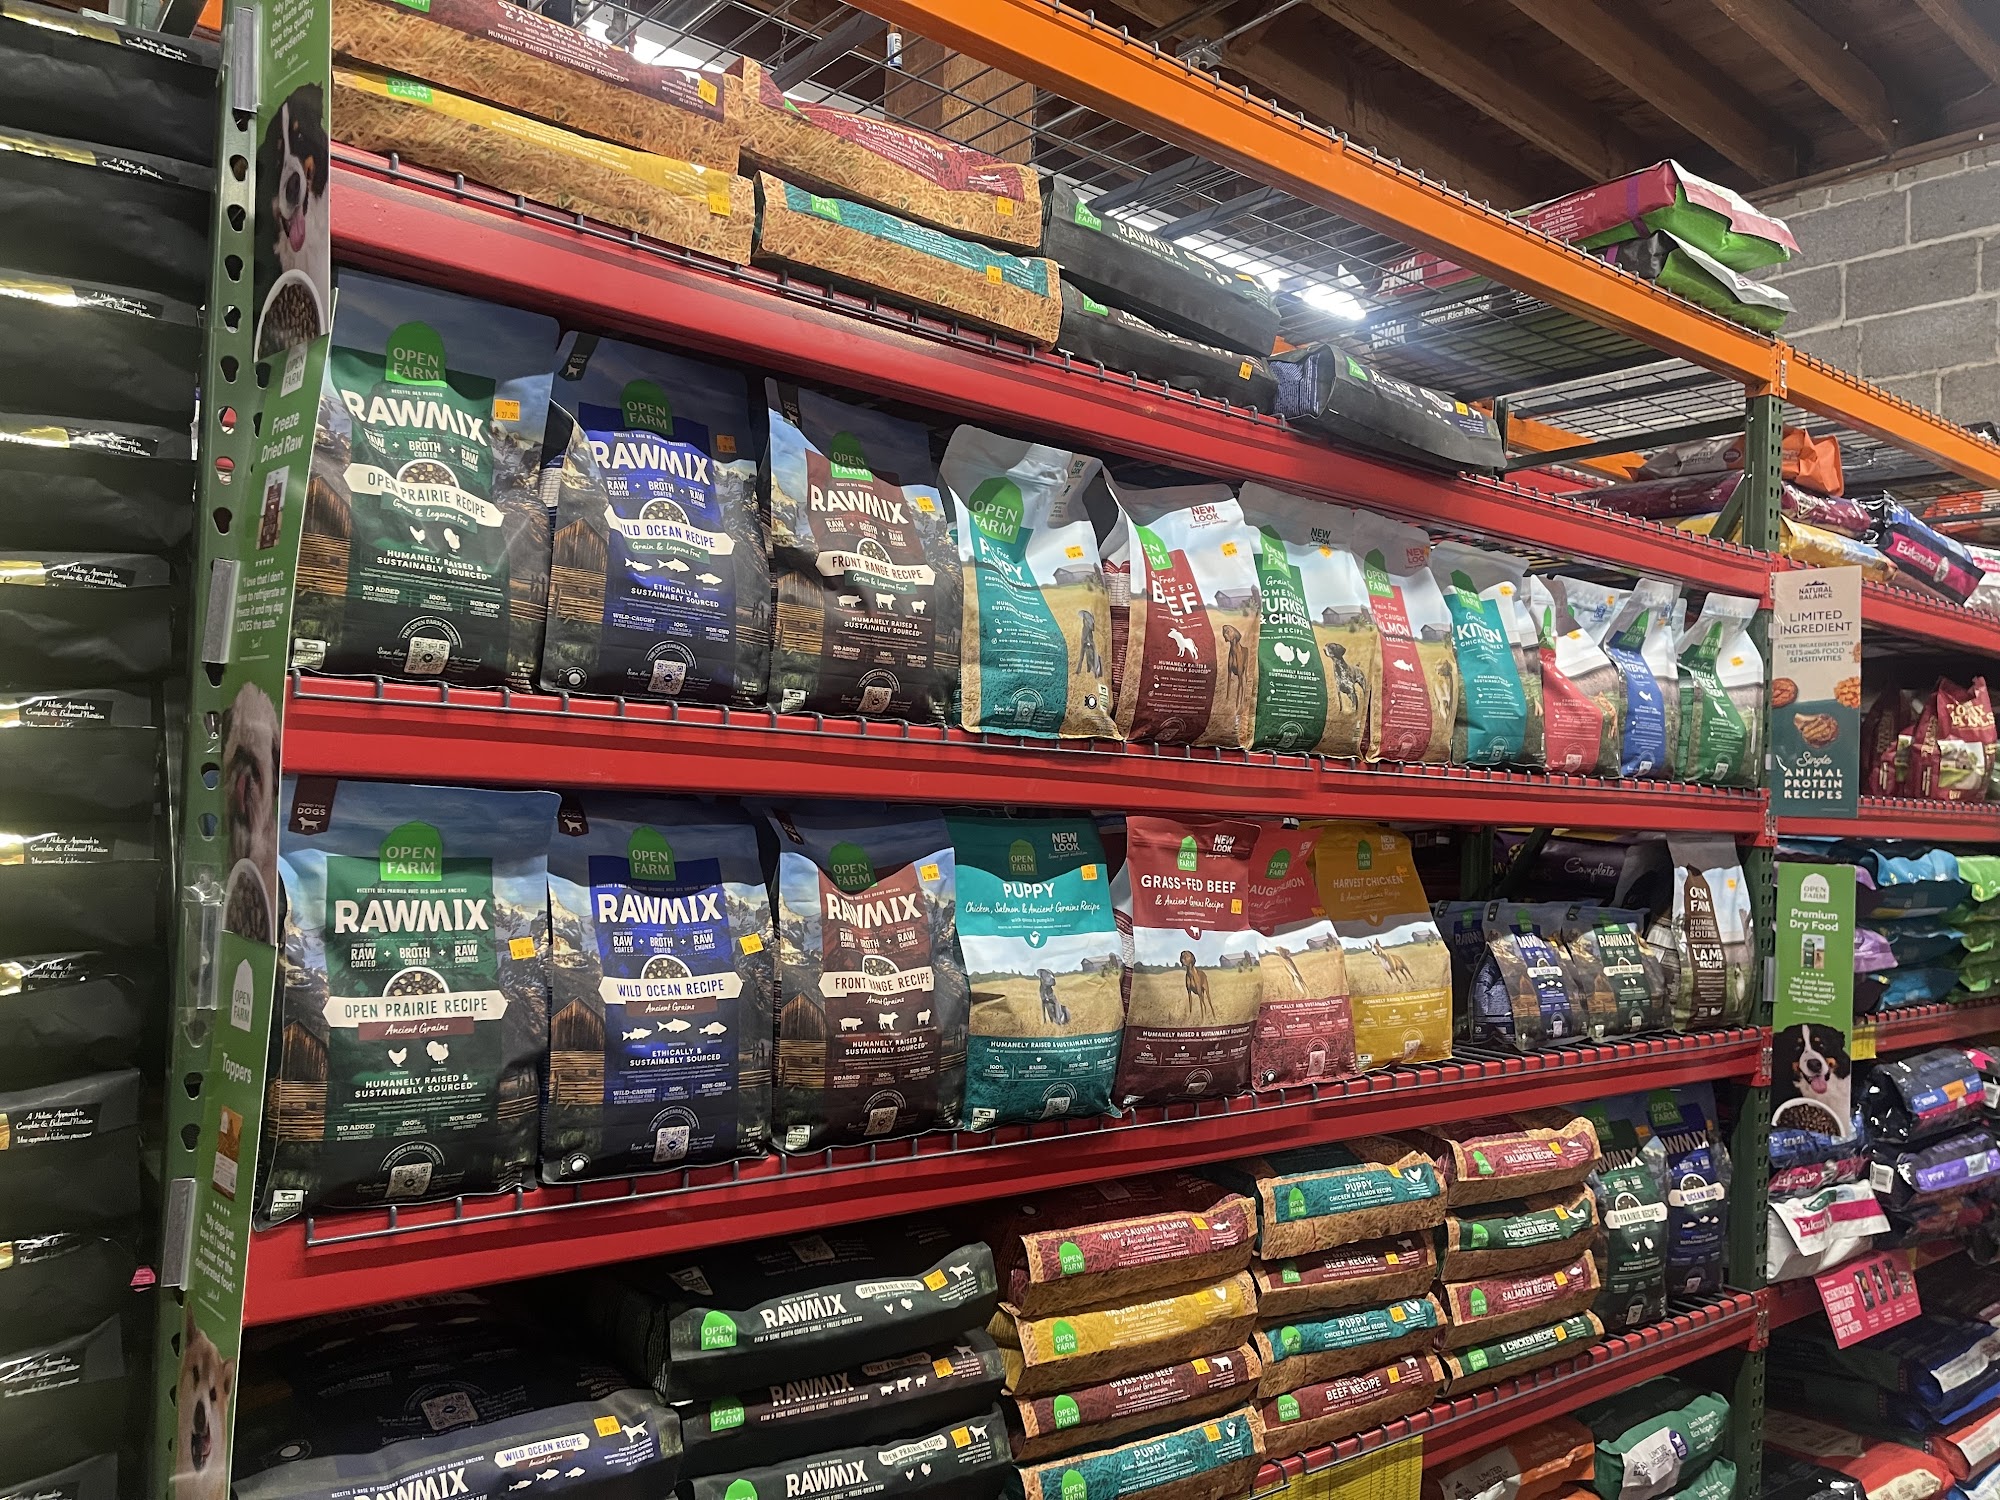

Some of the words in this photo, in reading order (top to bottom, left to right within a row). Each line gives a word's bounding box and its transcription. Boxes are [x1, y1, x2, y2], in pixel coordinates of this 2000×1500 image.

[488, 30, 523, 46] HUMANELY
[525, 42, 548, 55] RAISED
[556, 54, 595, 71] SUSTAINABLY
[1078, 214, 1100, 227] FARM
[1117, 222, 1178, 258] RAWMIX
[393, 347, 439, 368] OPEN
[393, 362, 440, 380] FARM
[271, 412, 300, 436] Freeze
[341, 389, 487, 446] RAWMIX
[261, 440, 282, 464] Dried
[284, 434, 304, 452] Raw
[409, 441, 441, 453] BROTH
[589, 440, 711, 486] RAWMIX
[607, 481, 628, 490] RAW
[648, 481, 674, 493] BROTH
[368, 472, 398, 494] OPEN
[401, 488, 450, 504] PRAIRIE
[456, 494, 486, 518] RECIPE
[811, 484, 909, 525] RAWMIX
[1191, 505, 1216, 515] NEW
[1193, 513, 1219, 522] LOOK
[1310, 527, 1331, 538] NEW
[1897, 540, 1937, 571] Eukanuba
[832, 556, 861, 569] FRONT
[864, 561, 890, 577] RANGE
[892, 567, 923, 580] RECIPE
[52, 571, 75, 580] Complete
[84, 575, 106, 584] Balanced
[107, 578, 127, 588] Nutrition
[1159, 576, 1176, 584] Free
[1367, 570, 1388, 581] OPEN
[1799, 586, 1833, 594] NATURAL
[631, 587, 684, 602] SUSTAINABLY
[686, 596, 719, 608] SOURCED
[469, 600, 500, 610] NON-GMO
[612, 613, 656, 624] WILD-CAUGHT
[1260, 615, 1267, 624] &
[1268, 614, 1311, 630] CHICKEN
[1789, 610, 1843, 622] LIMITED
[852, 617, 890, 626] HUMANELY
[891, 621, 913, 629] RAISED
[1780, 622, 1853, 635] INGREDIENT
[1457, 622, 1502, 643] KITTEN
[26, 708, 49, 717] Complete
[51, 709, 58, 717] &
[59, 710, 83, 718] Balanced
[83, 710, 105, 719] Nutrition
[1796, 751, 1832, 767] Single
[1784, 778, 1843, 789] PROTEIN
[1784, 789, 1842, 800] RECIPES
[297, 807, 326, 816] DOGS
[1052, 832, 1077, 843] NEW
[1214, 834, 1235, 845] NEW
[31, 844, 54, 853] Complete
[64, 844, 88, 852] Balanced
[386, 846, 436, 859] OPEN
[1054, 842, 1080, 852] LOOK
[1011, 855, 1034, 863] OPEN
[386, 862, 435, 874] FARM
[634, 863, 670, 875] FARM
[833, 863, 868, 874] OPEN
[1564, 857, 1617, 883] Complete
[836, 873, 871, 886] FARM
[1141, 875, 1203, 892] GRASS-FED
[1207, 881, 1236, 893] BEEF
[1333, 877, 1365, 889] HARVEST
[1365, 875, 1404, 886] CHICKEN
[1804, 892, 1827, 900] FARM
[597, 893, 723, 925] RAWMIX
[826, 893, 922, 929] RAWMIX
[1791, 908, 1838, 920] Premium
[334, 899, 490, 933] RAWMIX
[1790, 919, 1809, 931] Dry
[1812, 921, 1839, 932] Food
[1598, 933, 1635, 948] RAWMIX
[351, 948, 376, 961] RAW
[399, 947, 430, 959] BROTH
[351, 960, 376, 968] COATED
[835, 977, 866, 990] FRONT
[898, 972, 930, 988] RECIPE
[617, 984, 642, 998] WILD
[646, 984, 681, 997] OCEAN
[686, 979, 725, 995] RECIPE
[345, 1004, 379, 1018] OPEN
[385, 1001, 437, 1017] PRAIRIE
[445, 998, 487, 1013] RECIPE
[853, 1039, 893, 1048] HUMANELY
[895, 1037, 918, 1046] RAISED
[991, 1040, 1029, 1049] HUMANELY
[1057, 1039, 1093, 1048] SUSTAINABLY
[652, 1048, 693, 1057] ETHICALLY
[629, 1057, 684, 1067] SUSTAINABLY
[686, 1054, 721, 1063] SOURCED
[222, 1052, 252, 1084] Toppers
[365, 1077, 421, 1089] HUMANELY
[424, 1075, 459, 1085] RAISED
[462, 1073, 469, 1081] &
[1651, 1101, 1675, 1113] OPEN
[1653, 1110, 1678, 1123] FARM
[16, 1122, 40, 1130] Complete
[49, 1119, 72, 1127] Balanced
[1504, 1154, 1533, 1164] SALMON
[1534, 1152, 1557, 1160] RECIPE
[1344, 1180, 1373, 1192] PUPPY
[1329, 1193, 1351, 1202] CHICKEN
[1357, 1190, 1375, 1198] SALMON
[1620, 1211, 1641, 1222] PRAIRIE
[1641, 1207, 1660, 1218] RECIPE
[1101, 1225, 1156, 1241] WILD-CAUGHT
[1157, 1220, 1188, 1231] SALMON
[1062, 1254, 1081, 1265] OPEN
[1064, 1261, 1083, 1272] FARM
[860, 1284, 877, 1295] OPEN
[879, 1282, 900, 1293] PRAIRIE
[901, 1280, 920, 1290] RECIPE
[1502, 1286, 1533, 1301] SALMON
[1533, 1281, 1558, 1295] RECIPE
[760, 1294, 847, 1329] RAWMIX
[705, 1325, 733, 1335] OPEN
[1324, 1330, 1345, 1338] CHICKEN
[1371, 1322, 1388, 1330] RECIPE
[706, 1335, 733, 1345] FARM
[1471, 1352, 1484, 1361] OPEN
[769, 1372, 854, 1406] RAWMIX
[1056, 1407, 1077, 1418] OPEN
[1280, 1403, 1297, 1412] OPEN
[1281, 1410, 1299, 1418] FARM
[714, 1413, 741, 1427] FARM
[1058, 1415, 1080, 1427] FARM
[503, 1449, 525, 1463] WILD
[527, 1443, 554, 1456] OCEAN
[555, 1436, 583, 1450] RECIPE
[900, 1445, 922, 1457] PRAIRIE
[923, 1437, 944, 1451] RECIPE
[786, 1460, 869, 1498] RAWMIX
[1064, 1483, 1085, 1493] OPEN
